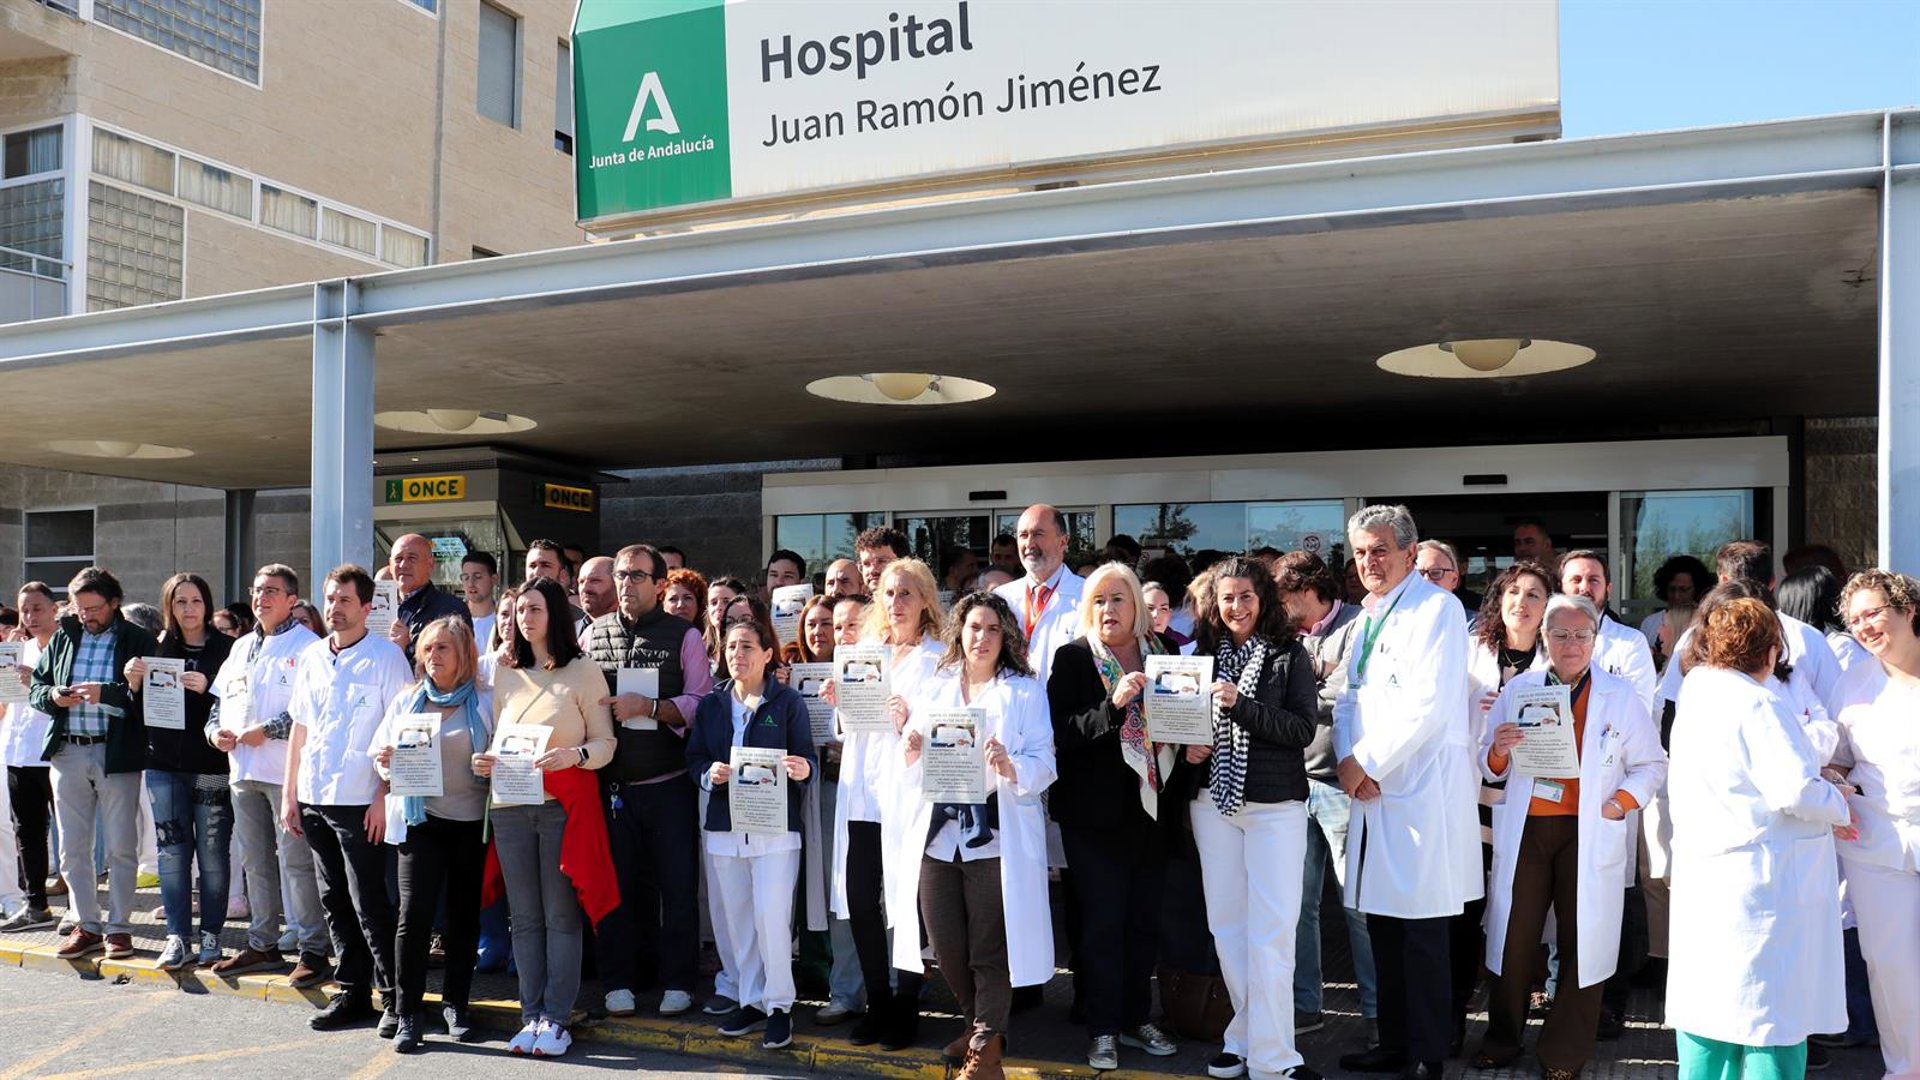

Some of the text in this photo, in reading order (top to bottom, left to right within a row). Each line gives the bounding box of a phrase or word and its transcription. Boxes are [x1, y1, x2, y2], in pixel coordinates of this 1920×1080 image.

[761, 1, 974, 82] Hospital
[763, 62, 1162, 146] Juan Ramón Jiménez
[589, 134, 714, 169] Junta de Andalucía
[409, 480, 458, 497] ONCE
[551, 488, 591, 507] ONCE
